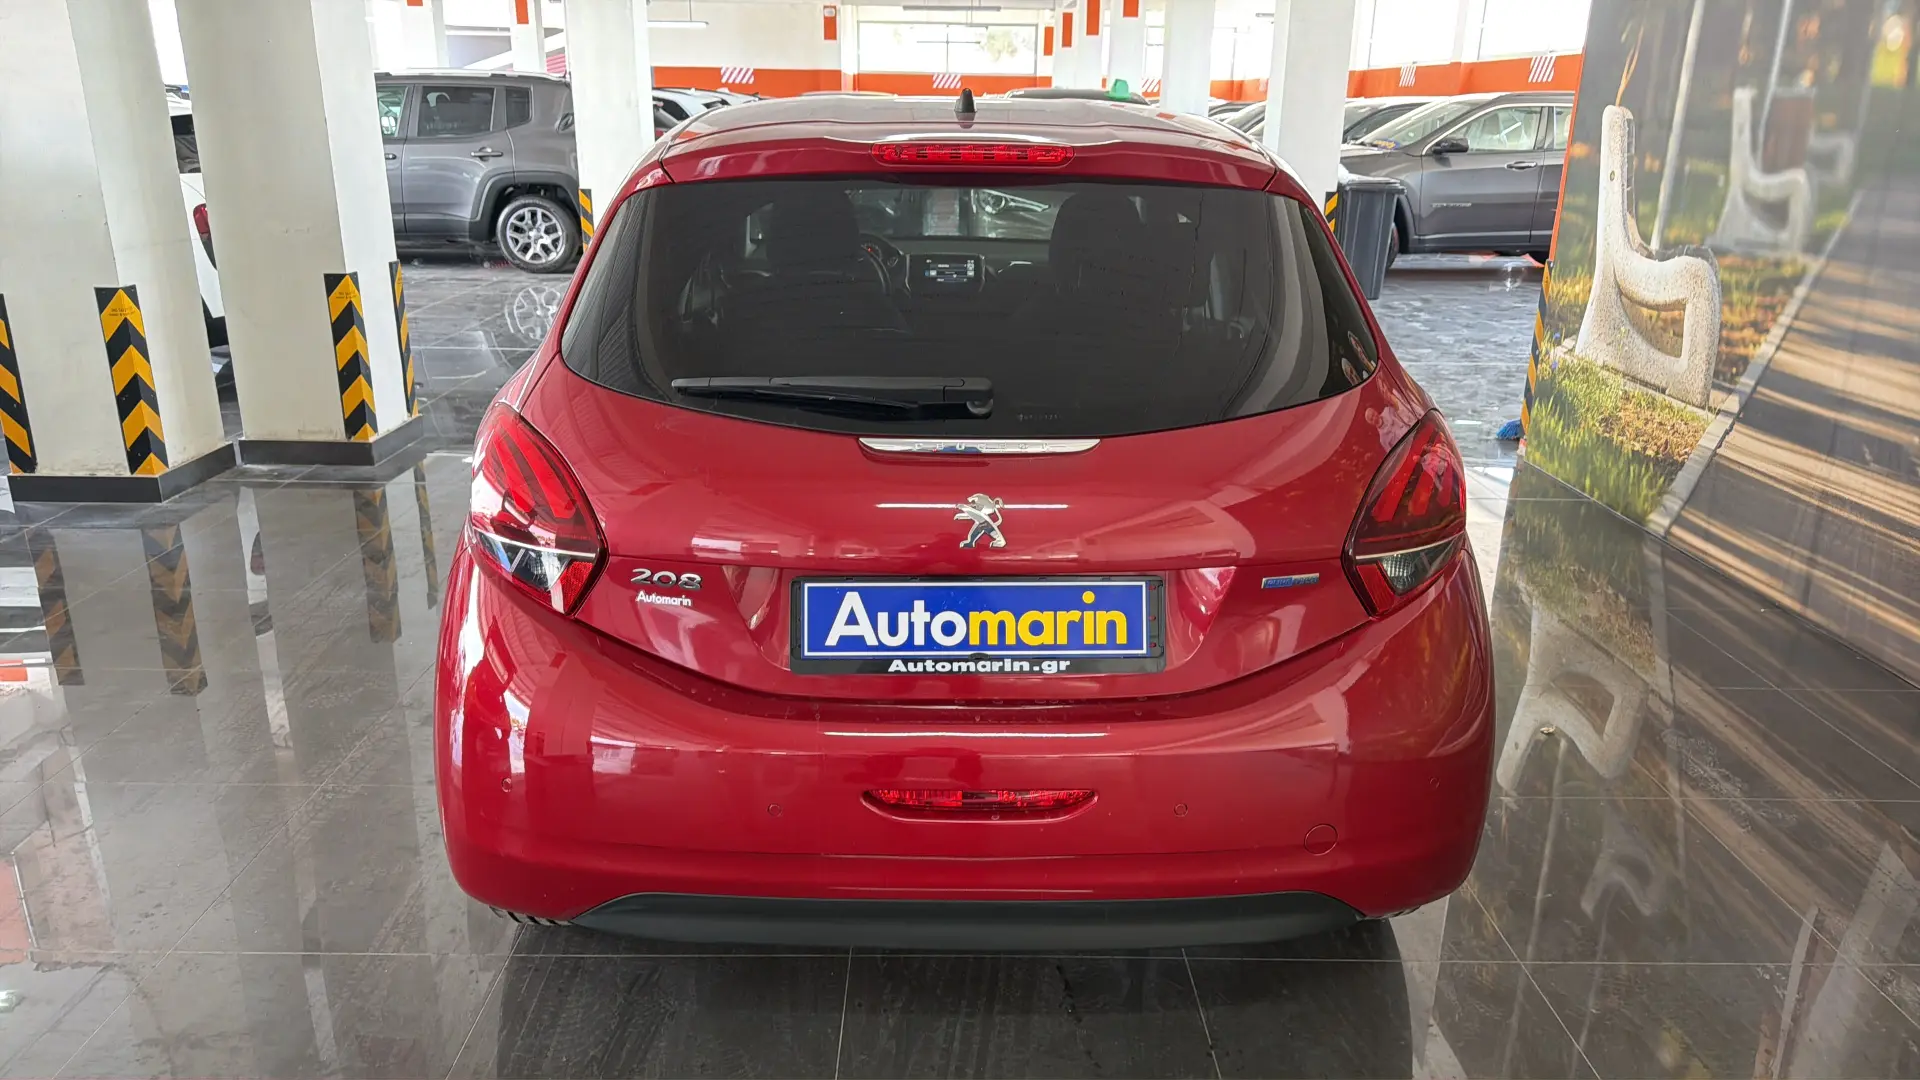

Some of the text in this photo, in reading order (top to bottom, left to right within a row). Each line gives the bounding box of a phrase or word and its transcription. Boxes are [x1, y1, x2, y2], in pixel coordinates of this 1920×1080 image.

[630, 567, 702, 590] 208
[635, 590, 692, 606] Automarin
[825, 591, 1128, 646] Automarin
[888, 659, 1071, 674] Automarin.gr
